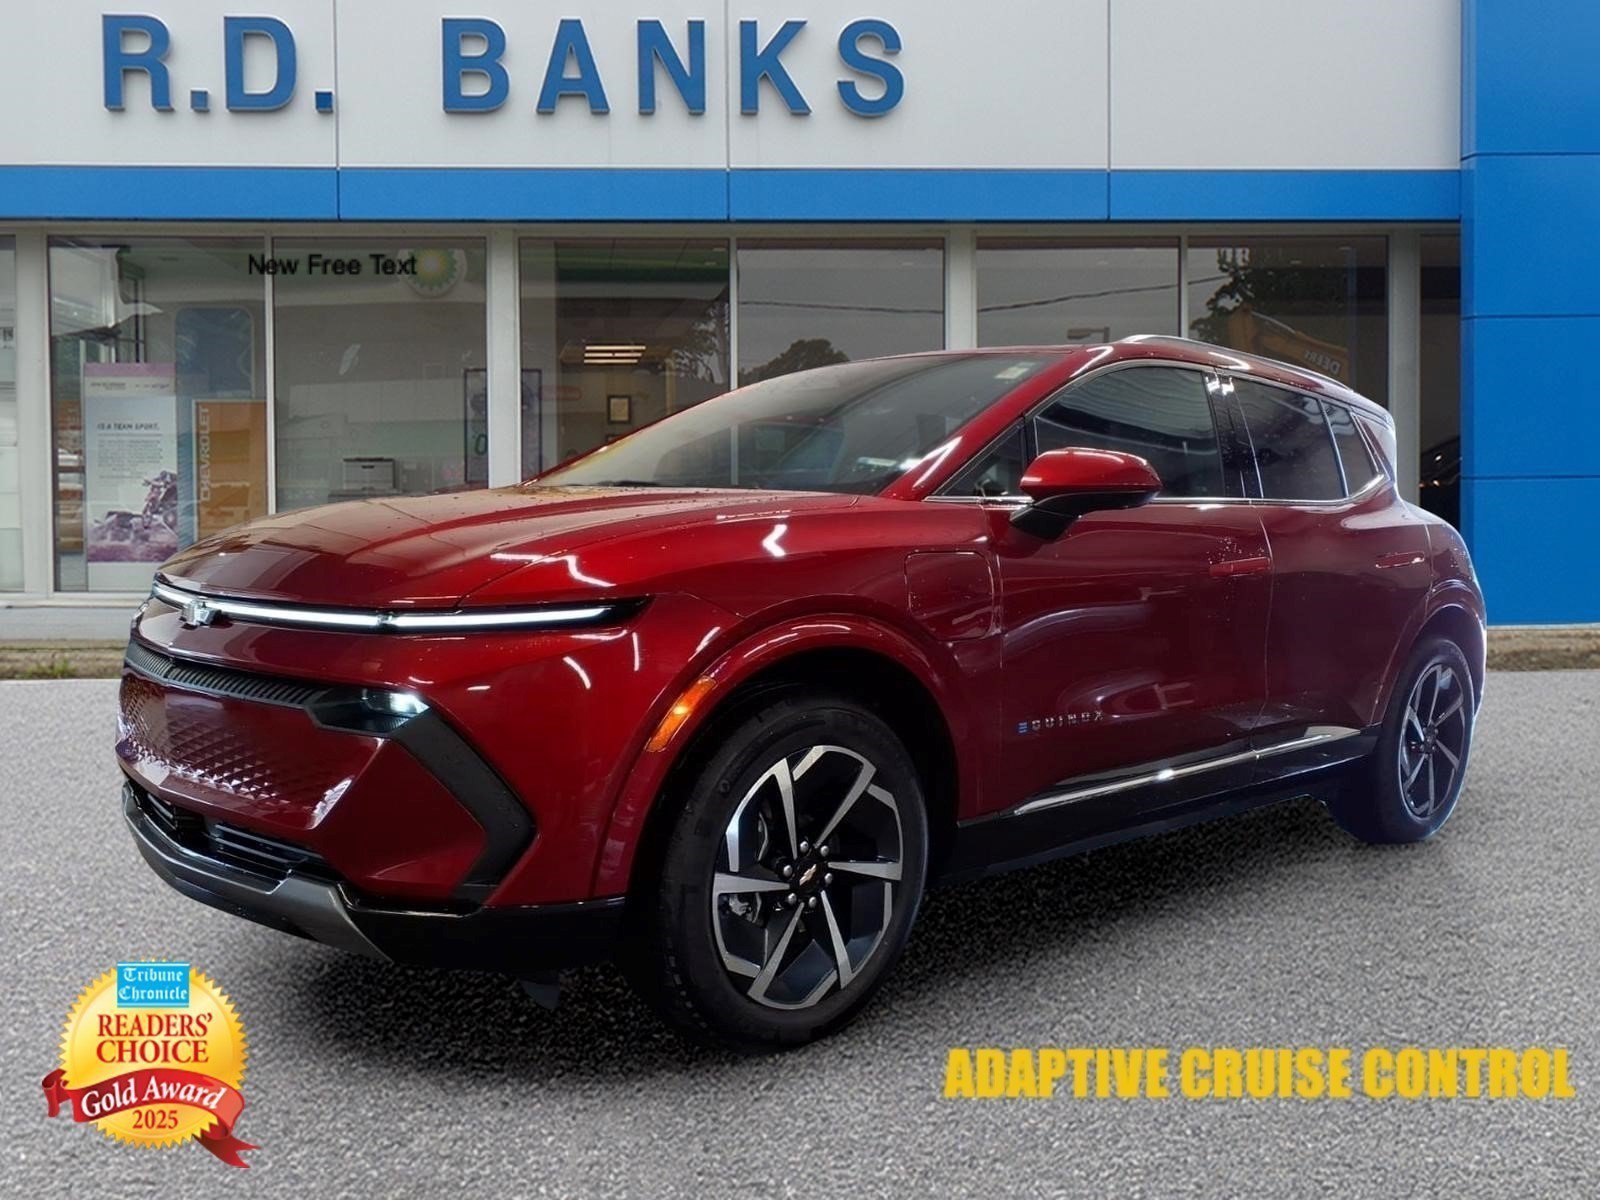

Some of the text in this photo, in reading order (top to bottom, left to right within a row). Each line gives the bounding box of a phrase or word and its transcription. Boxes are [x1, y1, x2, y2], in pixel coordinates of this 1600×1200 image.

[103, 14, 905, 117] R.D. BANKS
[200, 405, 210, 501] CHEVROLET
[1018, 710, 1103, 733] EQUINOX
